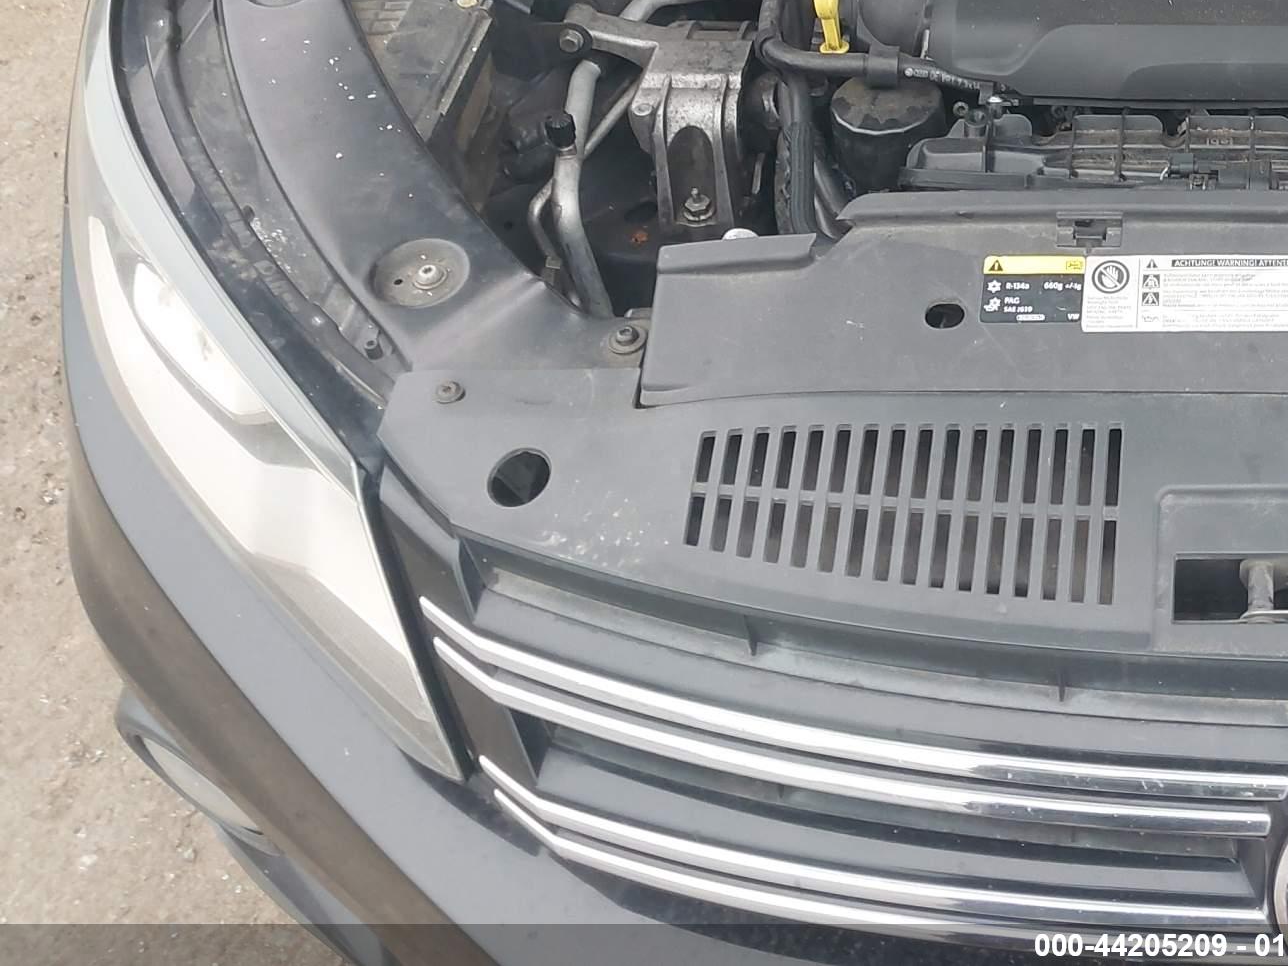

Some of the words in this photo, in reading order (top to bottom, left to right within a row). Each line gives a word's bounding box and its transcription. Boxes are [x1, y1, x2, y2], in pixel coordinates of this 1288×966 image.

[1174, 259, 1215, 267] ACHTUNG!
[1217, 259, 1257, 267] WARNING!
[1005, 282, 1030, 290] R-134a
[1004, 296, 1020, 305] PAG
